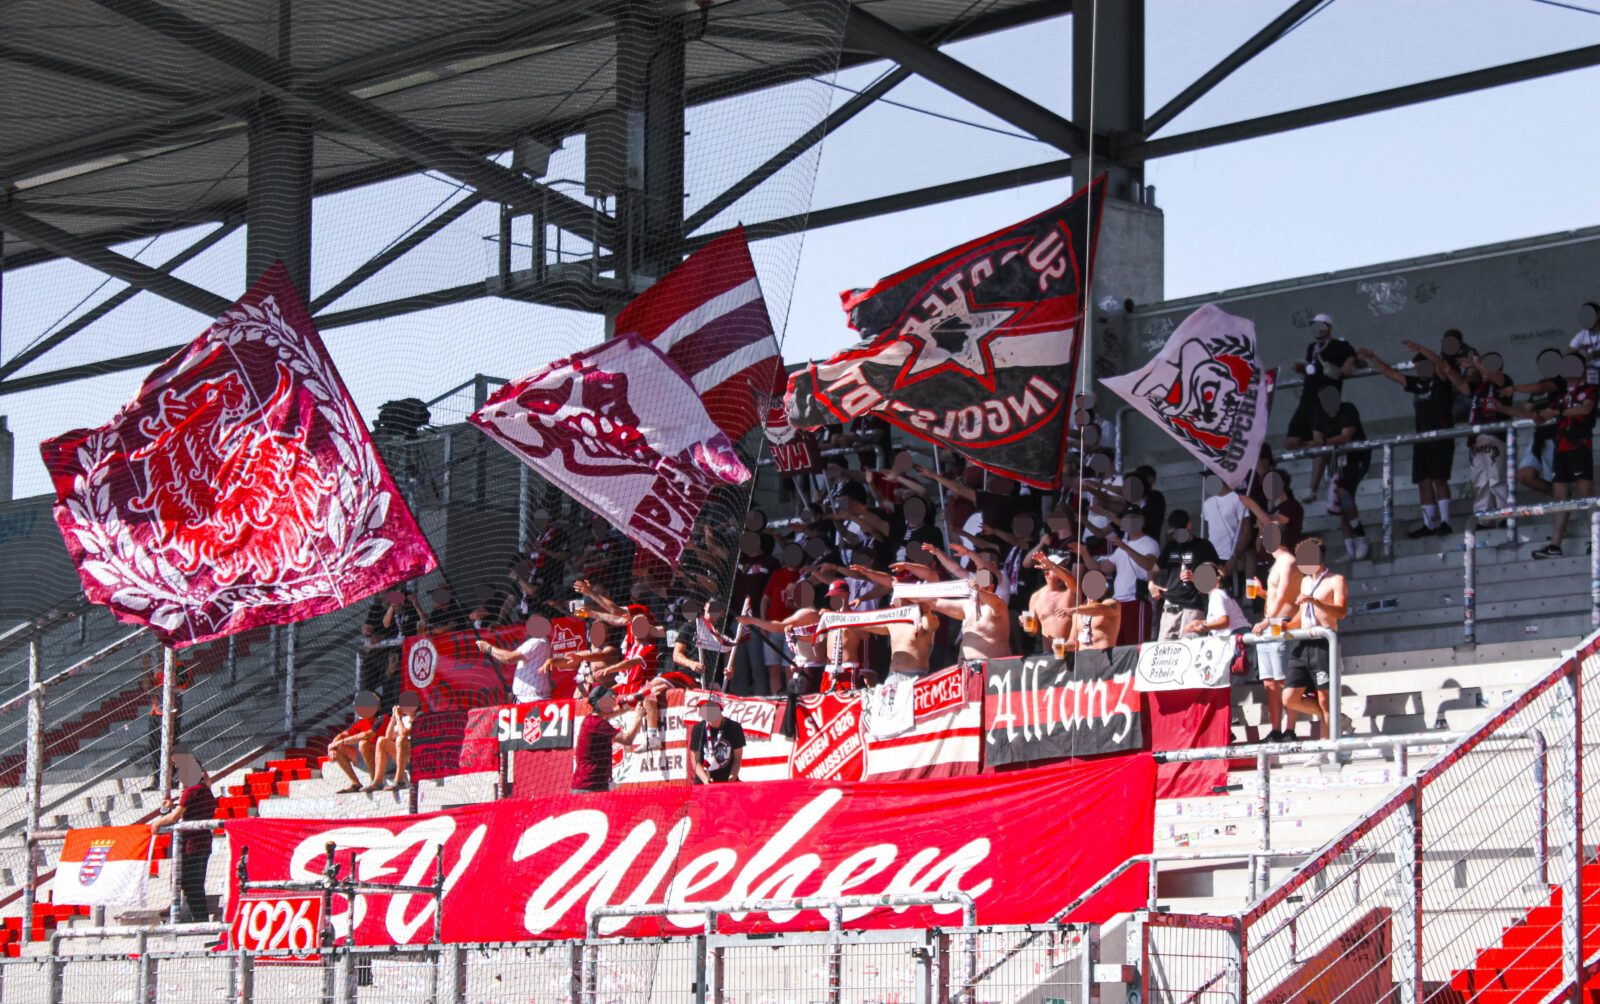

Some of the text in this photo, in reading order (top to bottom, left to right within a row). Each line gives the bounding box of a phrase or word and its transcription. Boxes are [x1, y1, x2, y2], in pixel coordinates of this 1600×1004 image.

[1153, 645, 1182, 656] Sektion
[685, 696, 775, 729] SCREW
[804, 706, 823, 737] SV
[986, 659, 1133, 746] Allianz
[498, 707, 523, 742] SL
[541, 703, 570, 738] 21
[795, 711, 855, 773] WEHEN 1926
[640, 755, 684, 772] ALLER
[290, 788, 994, 944] SV Wehen
[239, 900, 313, 958] 1926
